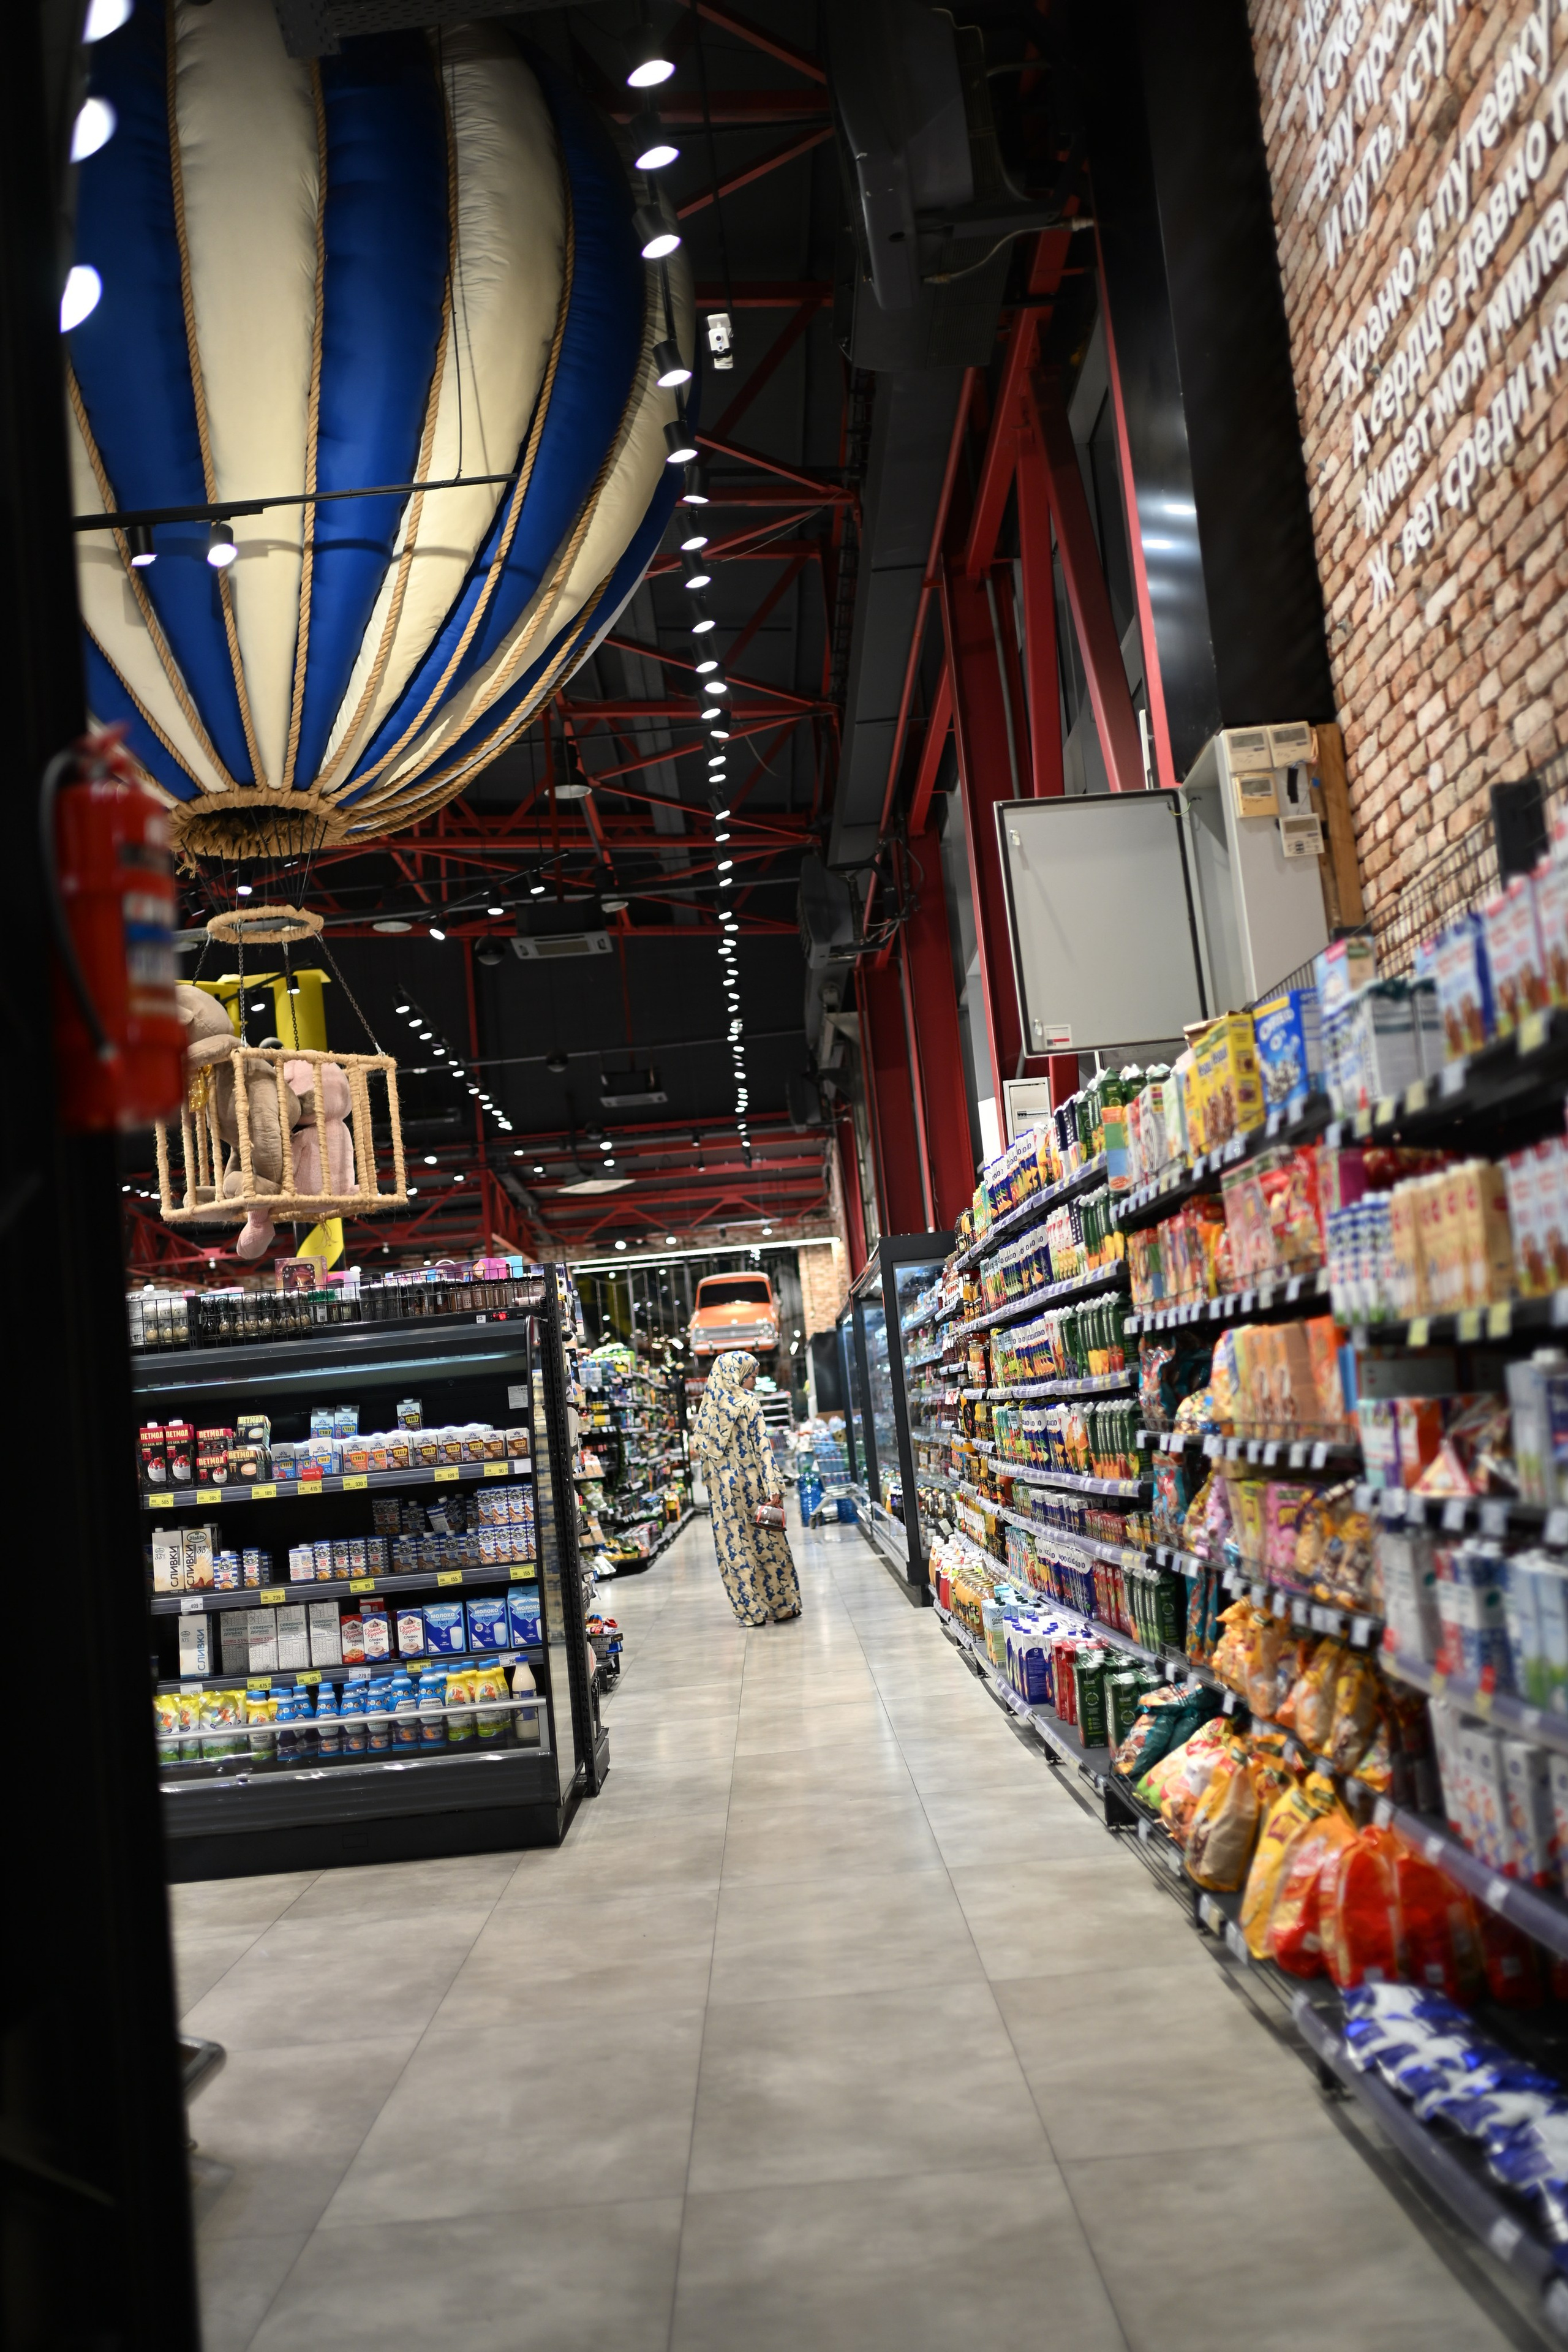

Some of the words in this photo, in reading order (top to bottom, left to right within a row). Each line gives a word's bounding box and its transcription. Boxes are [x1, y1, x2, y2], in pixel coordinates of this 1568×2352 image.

[1316, 92, 1354, 201] Ему
[1324, 203, 1343, 270] И
[1343, 123, 1392, 236] путь
[1352, 410, 1371, 469] А
[1370, 276, 1454, 436] сердце
[1457, 119, 1548, 311] давно
[1336, 246, 1415, 399] Храню
[1360, 403, 1433, 539] Живет
[1431, 322, 1487, 431] моя
[1487, 196, 1568, 349] мила
[1445, 360, 1530, 513] среди
[140, 1431, 164, 1440] ПЕТМОЛ
[165, 1430, 188, 1438] ПЕТМОЛ
[199, 1429, 224, 1438] ПЕТМОЛ
[229, 1450, 254, 1459] ПЕТМОЛ
[198, 1457, 224, 1466] ПЕТМОЛ
[169, 1545, 178, 1587] СЛИВКИ
[185, 1544, 195, 1586] СЛИВКИ
[197, 1629, 205, 1671] СЛИВКИ
